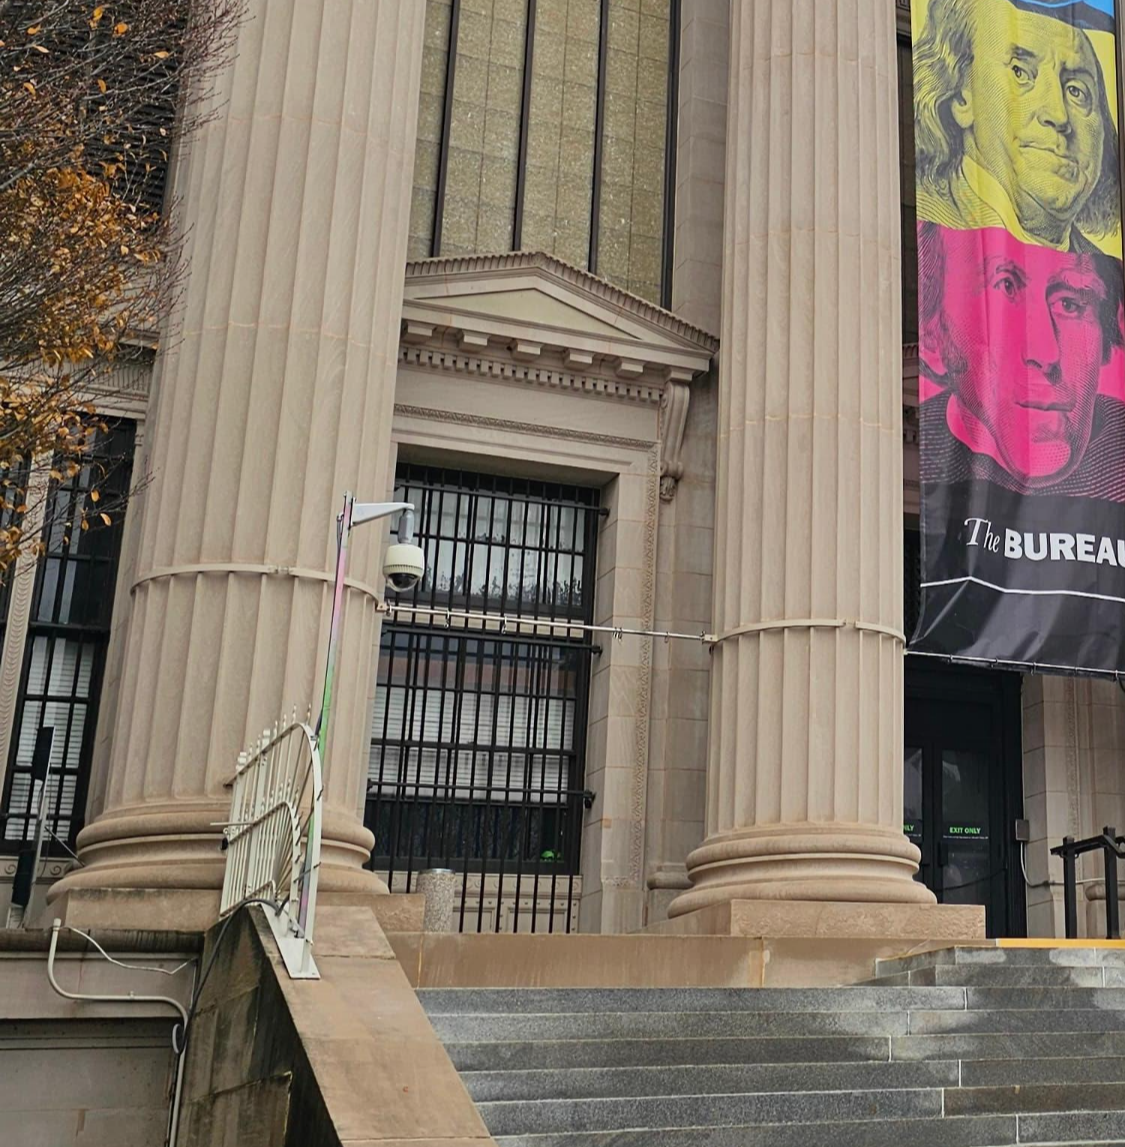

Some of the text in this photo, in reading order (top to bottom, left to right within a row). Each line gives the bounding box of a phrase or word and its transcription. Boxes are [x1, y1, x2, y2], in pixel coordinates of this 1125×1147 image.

[964, 517, 1000, 553] The
[949, 826, 981, 835] EXIT ONLY
